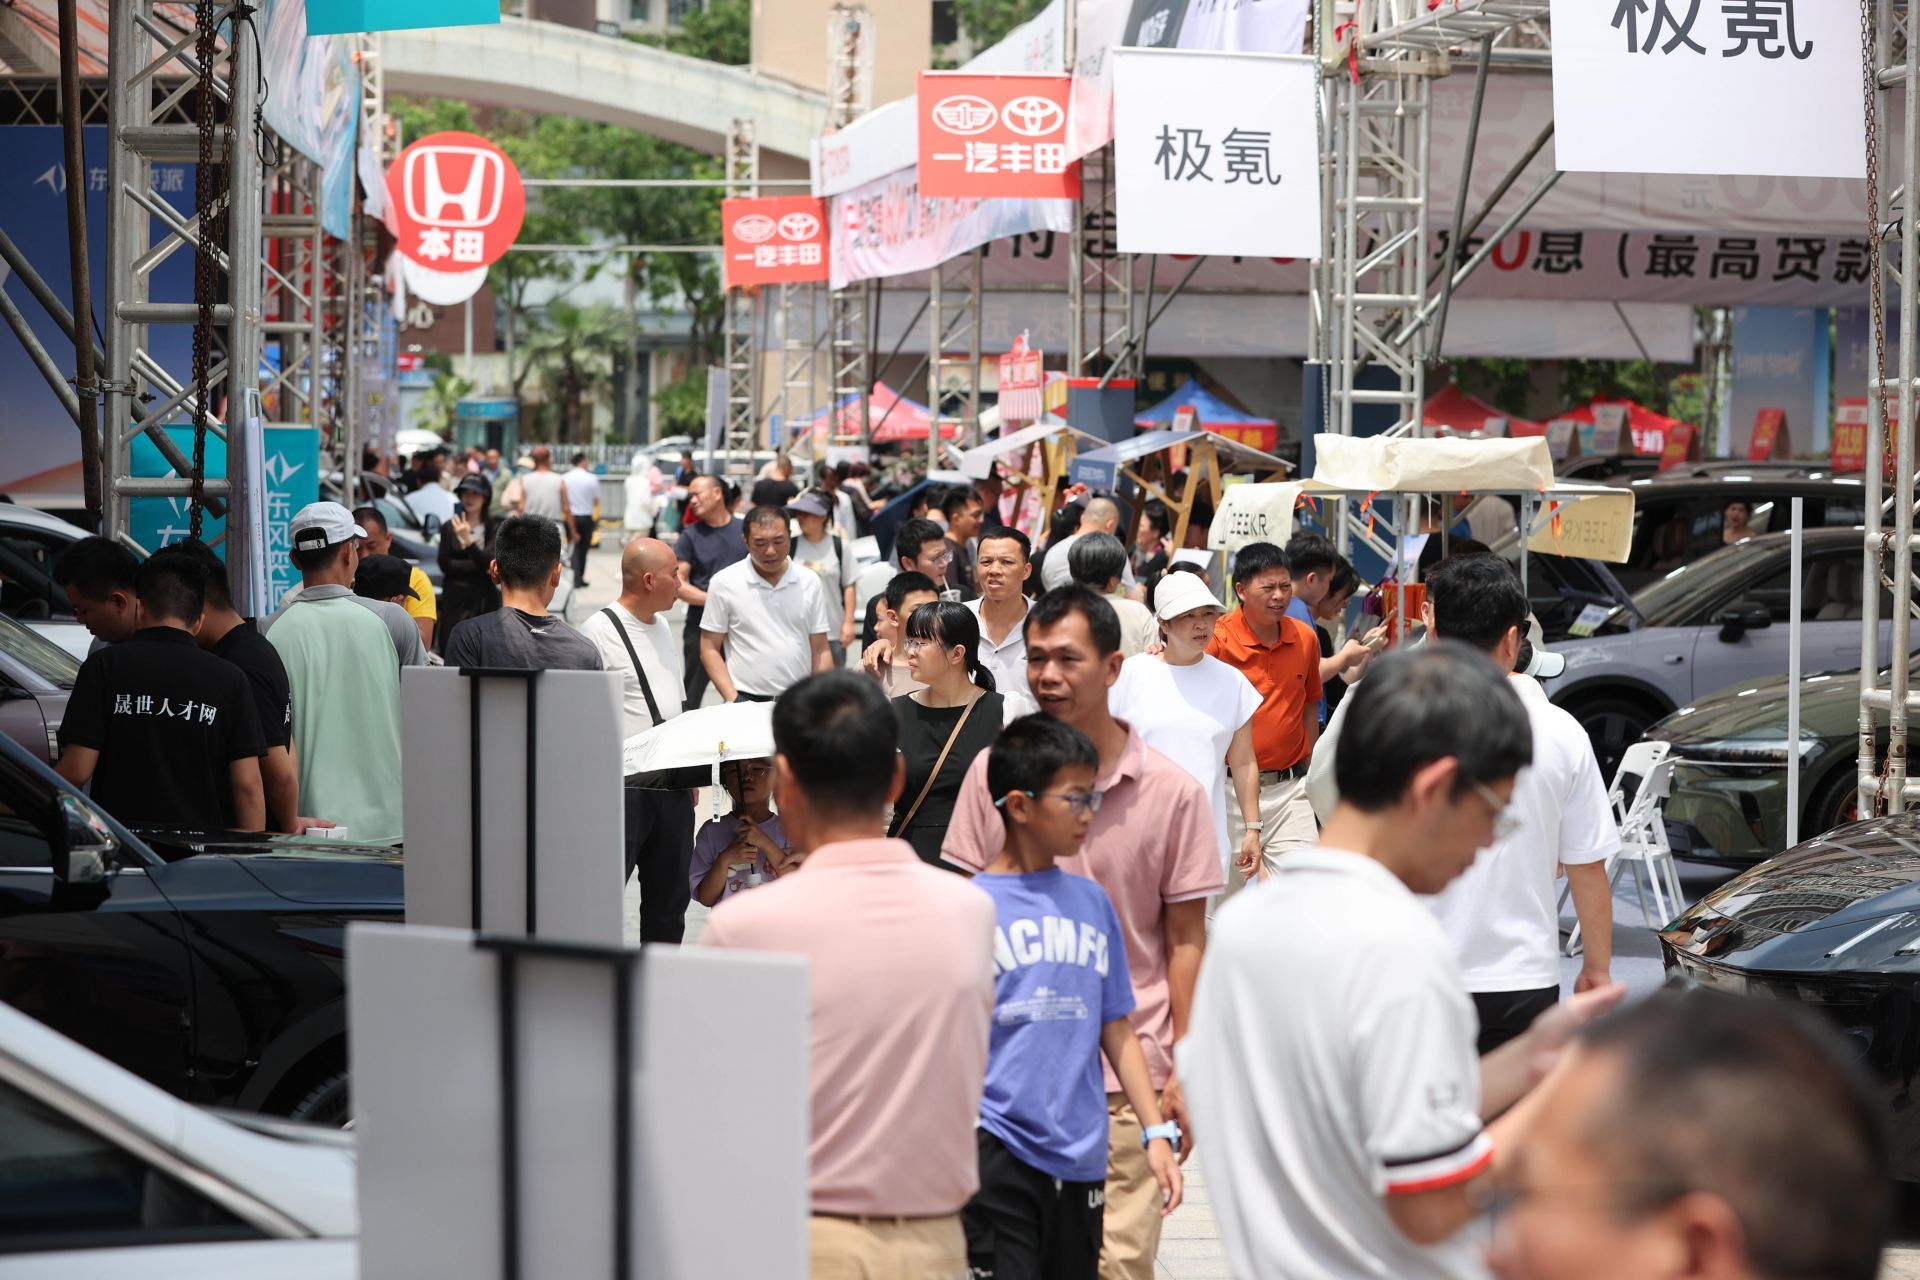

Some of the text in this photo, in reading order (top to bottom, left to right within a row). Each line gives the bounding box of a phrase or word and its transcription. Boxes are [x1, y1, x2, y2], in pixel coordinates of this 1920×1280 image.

[1610, 0, 1814, 59] 极氪
[932, 141, 1067, 175] 一汽丰田
[1153, 124, 1283, 186] 极氪
[89, 168, 185, 192] 东派
[417, 228, 485, 264] 本田
[733, 242, 821, 269] 一汽丰田
[1230, 513, 1268, 537] ZEEKR
[113, 694, 218, 726] 晟世人才网
